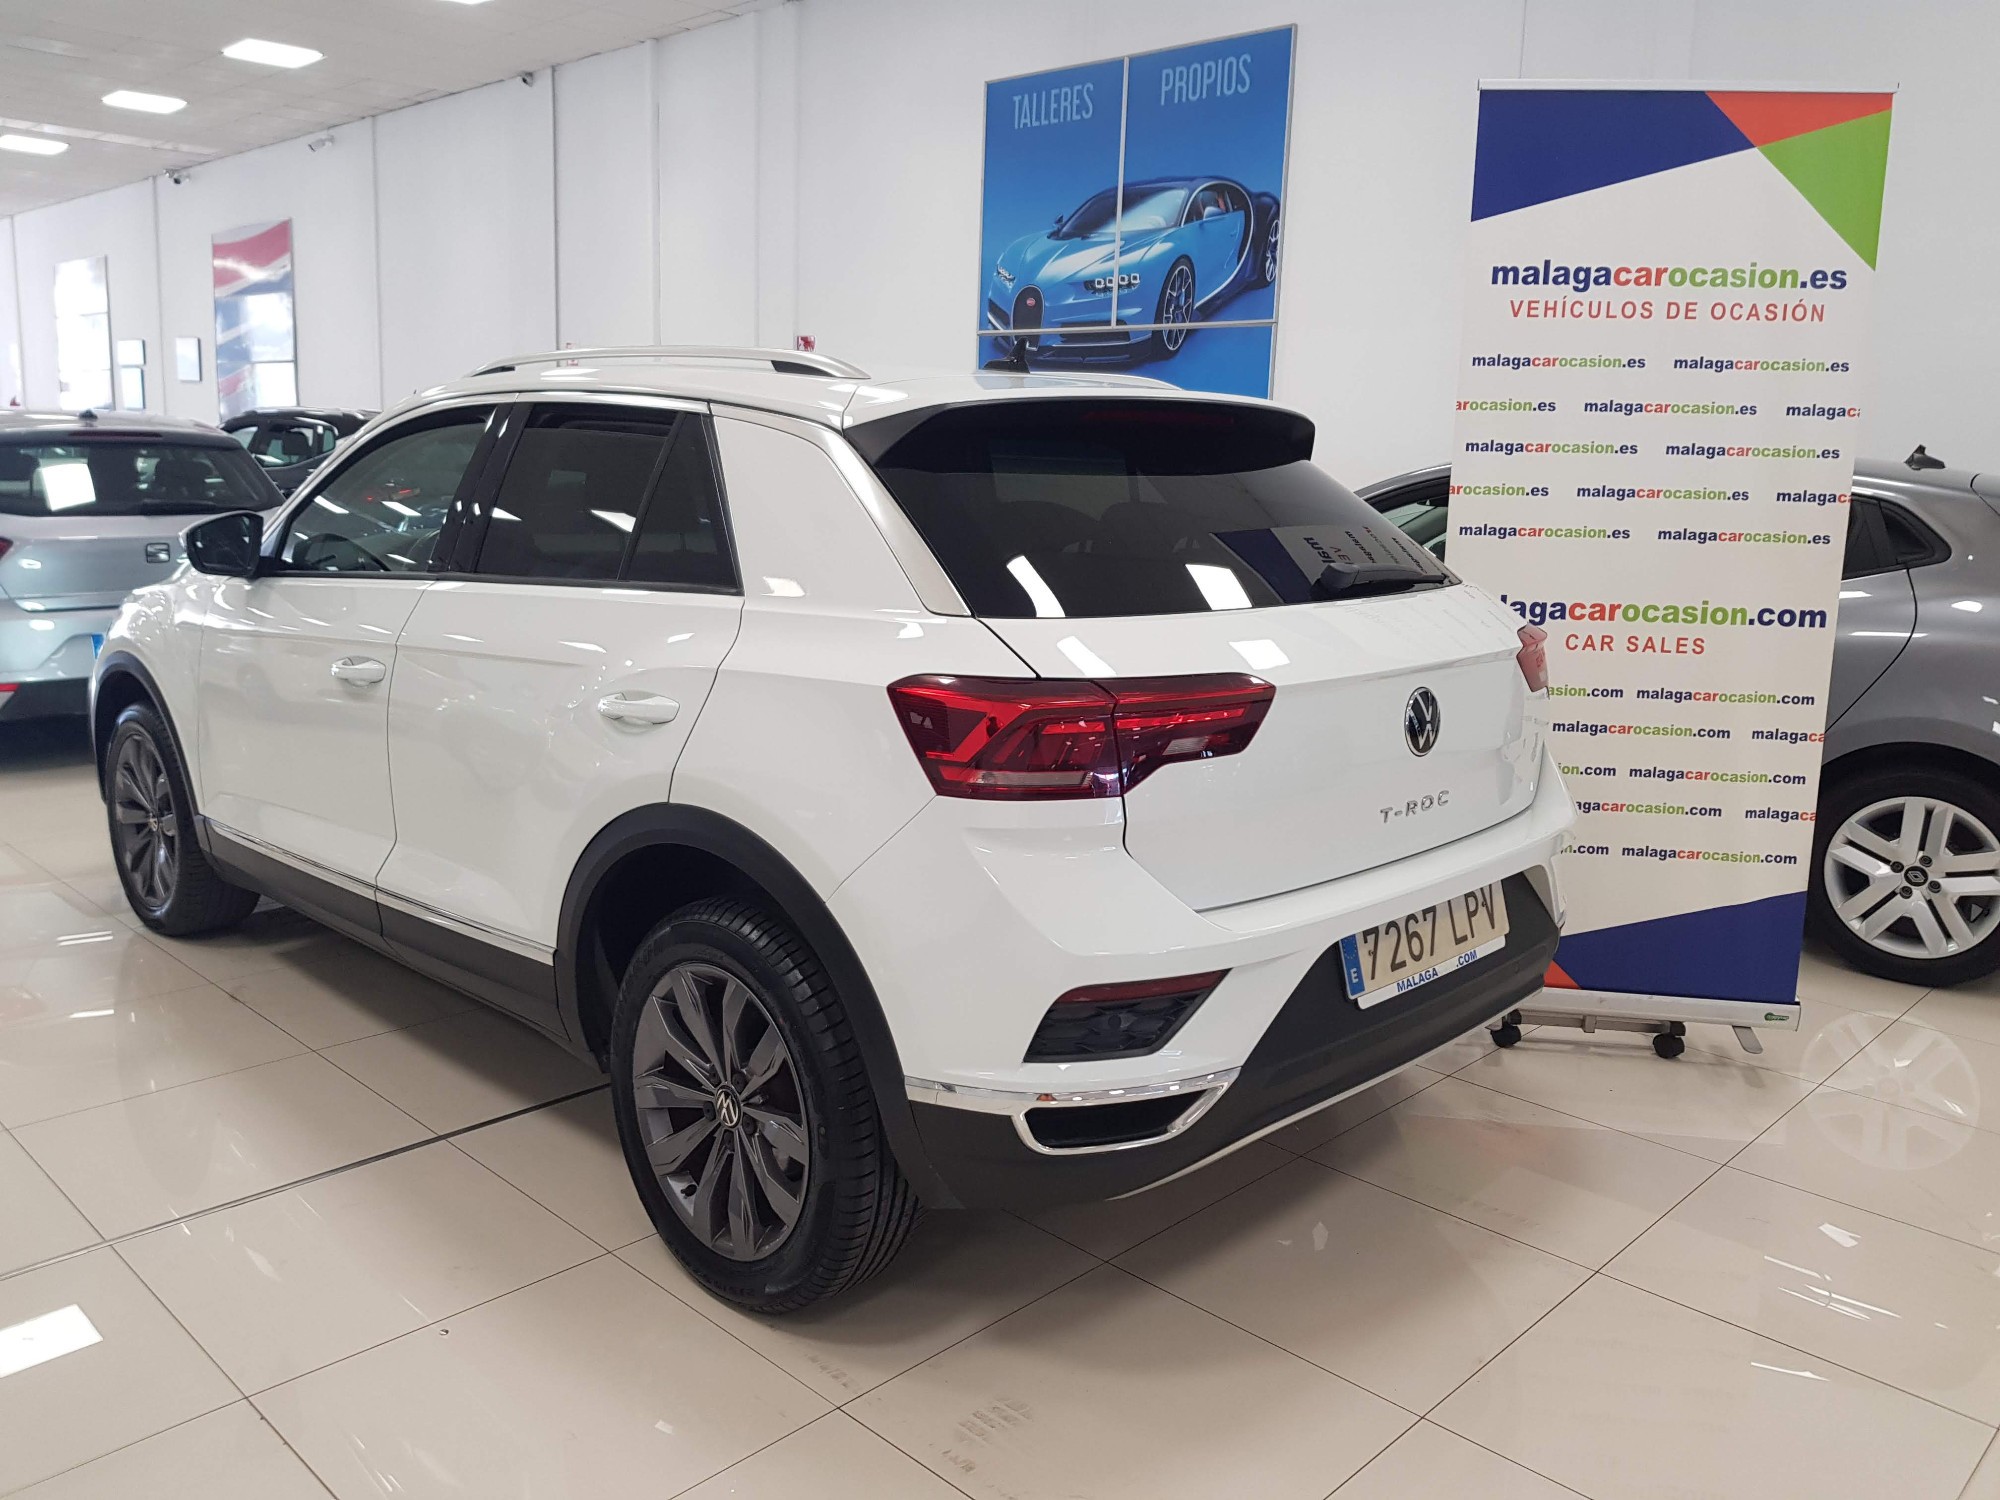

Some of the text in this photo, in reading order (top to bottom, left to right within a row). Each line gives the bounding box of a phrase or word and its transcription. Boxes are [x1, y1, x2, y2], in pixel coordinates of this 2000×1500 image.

[1013, 54, 1252, 129] TALLERES PROPIOS
[1491, 259, 1847, 291] malagacarocasion.es
[1510, 296, 1825, 322] VEHÍCULOS DE OCASIÓN
[1472, 354, 1849, 373] malagacarocasion.es malagacarocasion.es
[1584, 400, 1757, 416] malagacarocasion.es
[1466, 440, 1840, 460] malagacarocasion.es malagacarocasion.es
[1577, 485, 1749, 501] malagacarocasion.es
[1459, 524, 1831, 545] malagacarocasion.es malagacarocasion.es
[1565, 634, 1705, 655] CAR SALES
[1637, 688, 1815, 706] malagacarocasion.com
[1553, 721, 1730, 739] malagacarocasion.com
[1629, 767, 1806, 785] malagacarocasion.com
[1380, 790, 1450, 823] T-ROC
[1622, 846, 1797, 864] malagacarocasion.com
[1362, 884, 1496, 981] 7267 LPV
[1350, 967, 1359, 984] E
[1397, 950, 1478, 993] MALAGA .COM
